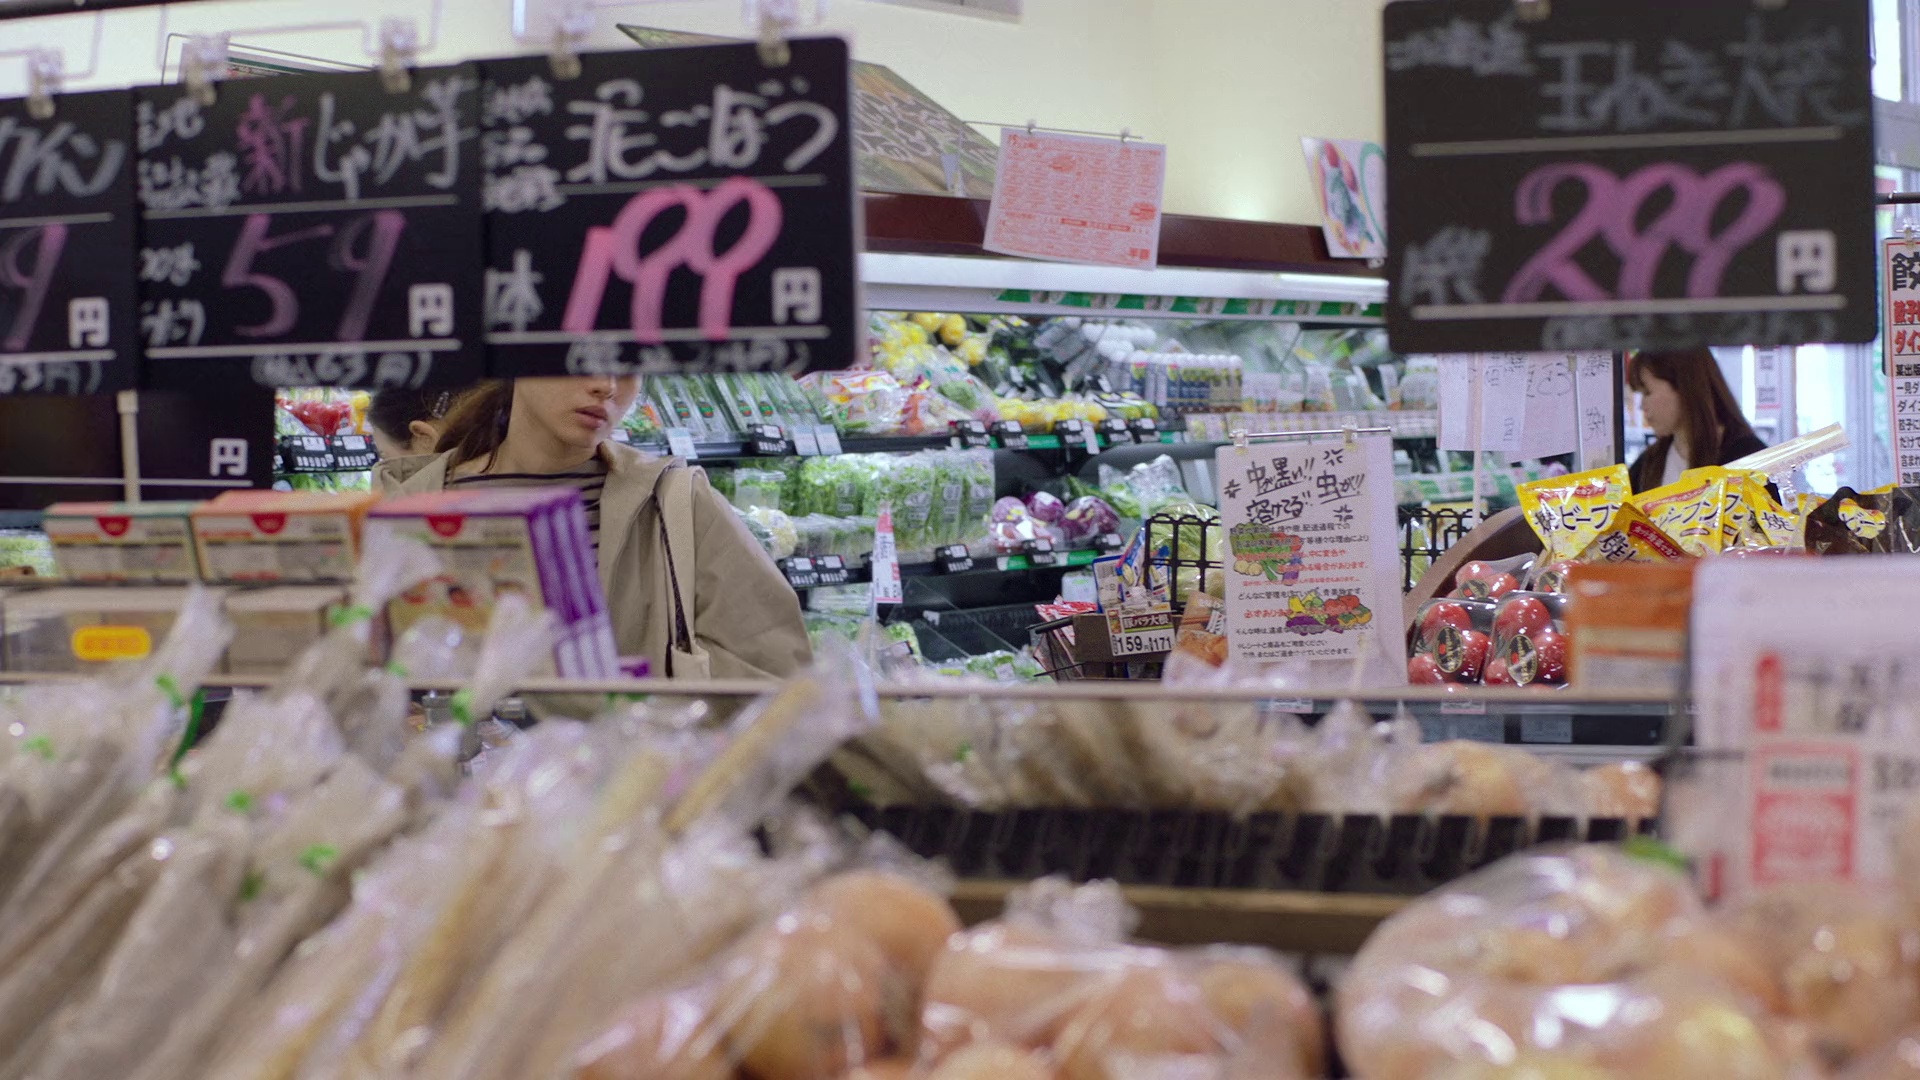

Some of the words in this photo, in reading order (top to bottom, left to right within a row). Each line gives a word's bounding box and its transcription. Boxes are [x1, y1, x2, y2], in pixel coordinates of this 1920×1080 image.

[562, 176, 783, 343] 199
[1505, 162, 1786, 303] 299
[222, 213, 406, 345] 59
[1776, 230, 1837, 294] 円
[69, 297, 109, 348] 円
[408, 283, 454, 338] 円
[771, 266, 822, 325] 円
[1895, 329, 1920, 355] ダイ
[209, 438, 248, 477] 円
[1534, 503, 1619, 535] 焼ビーフ
[1117, 635, 1143, 653] 159
